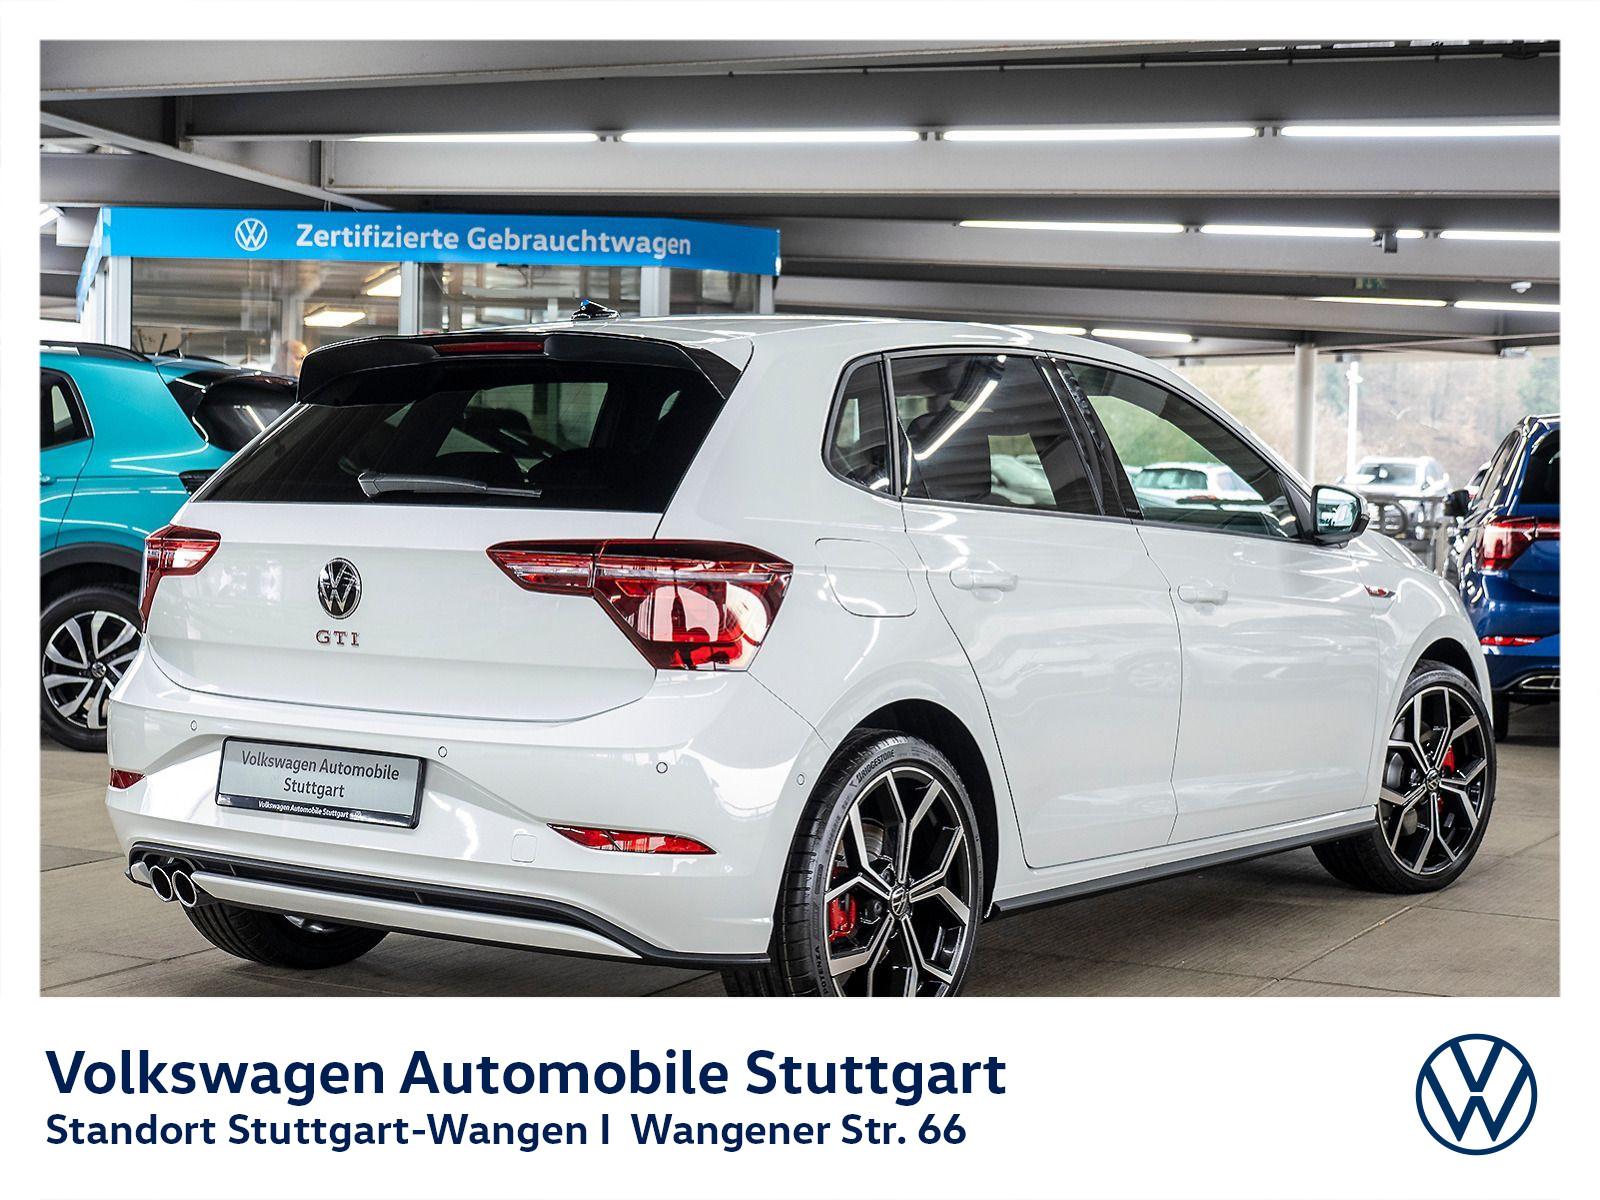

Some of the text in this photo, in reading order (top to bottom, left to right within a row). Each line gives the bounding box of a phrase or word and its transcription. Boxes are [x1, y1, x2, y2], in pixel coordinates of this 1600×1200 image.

[296, 223, 691, 260] Zertifizierte Gebrauchtwagen
[315, 629, 360, 647] GTI
[241, 750, 400, 781] Volkswagen Automobile
[283, 777, 345, 799] Stuttgart
[258, 800, 349, 819] Volkswagen Automobile Stuttgart
